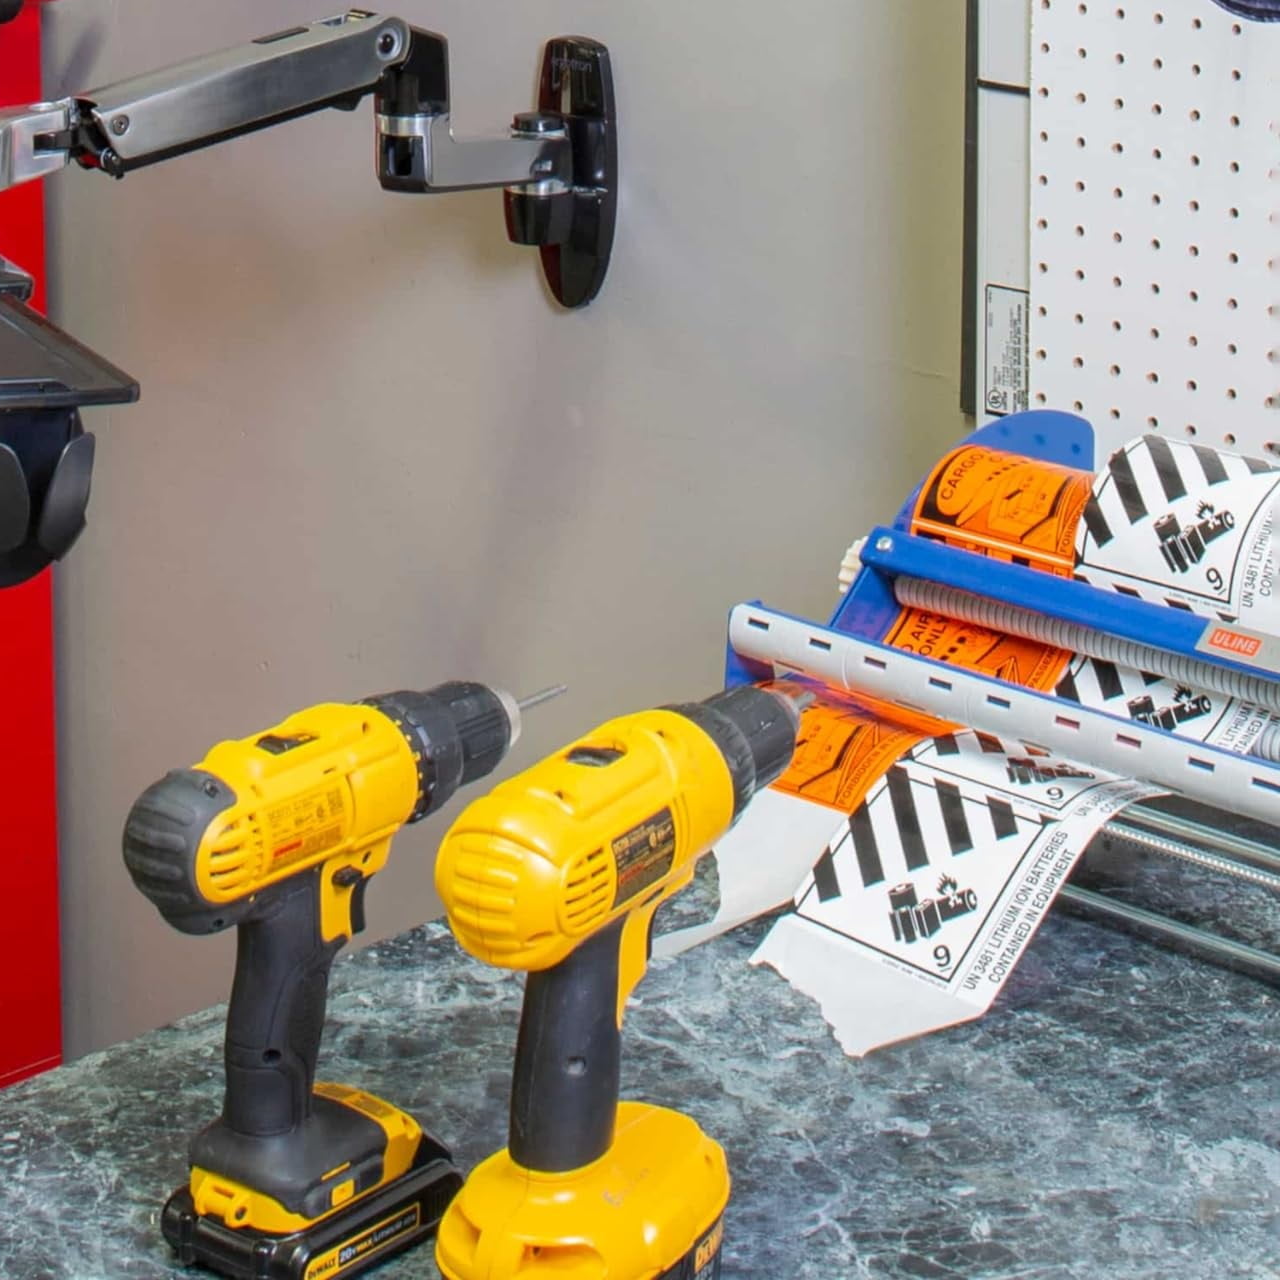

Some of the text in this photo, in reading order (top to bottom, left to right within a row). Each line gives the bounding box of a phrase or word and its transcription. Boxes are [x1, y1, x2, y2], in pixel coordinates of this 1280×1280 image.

[939, 452, 985, 501] CARGO
[1205, 567, 1224, 591] 9
[1213, 631, 1257, 653] ULINE
[1031, 849, 1076, 909] EQUIPMENT
[963, 971, 981, 990] UN
[974, 951, 994, 974] 3481
[988, 908, 1020, 949] LITHIUM
[1014, 885, 1033, 908] ION
[1026, 830, 1069, 885] BATTERIES
[1024, 909, 1040, 925] IN
[933, 944, 952, 968] 9
[988, 922, 1032, 984] CONTAINED
